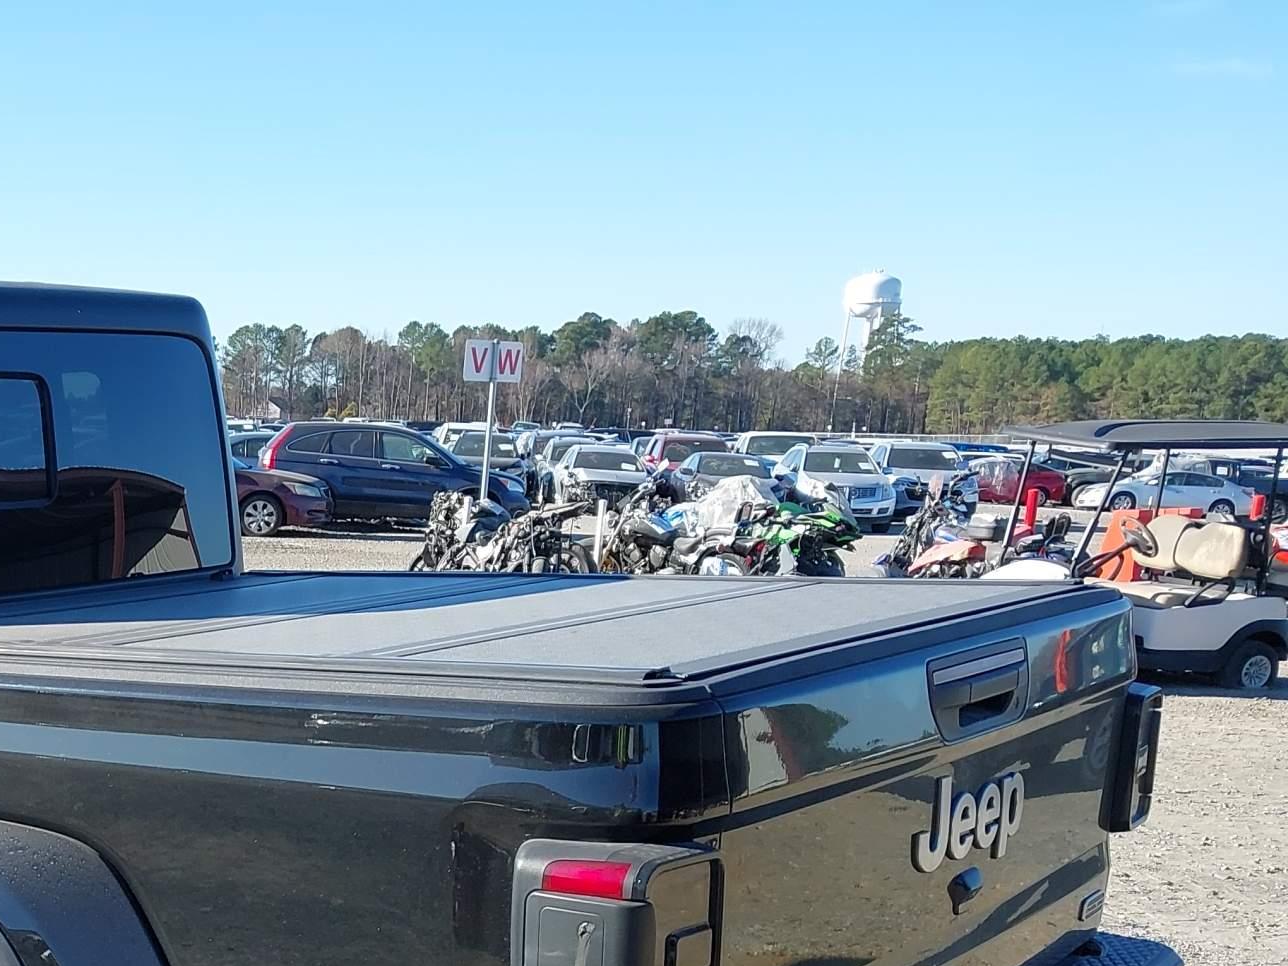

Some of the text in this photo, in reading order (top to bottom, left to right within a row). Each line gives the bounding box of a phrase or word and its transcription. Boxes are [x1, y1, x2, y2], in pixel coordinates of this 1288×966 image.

[471, 347, 489, 374] V
[498, 348, 521, 375] W
[911, 772, 1025, 873] Jeep
